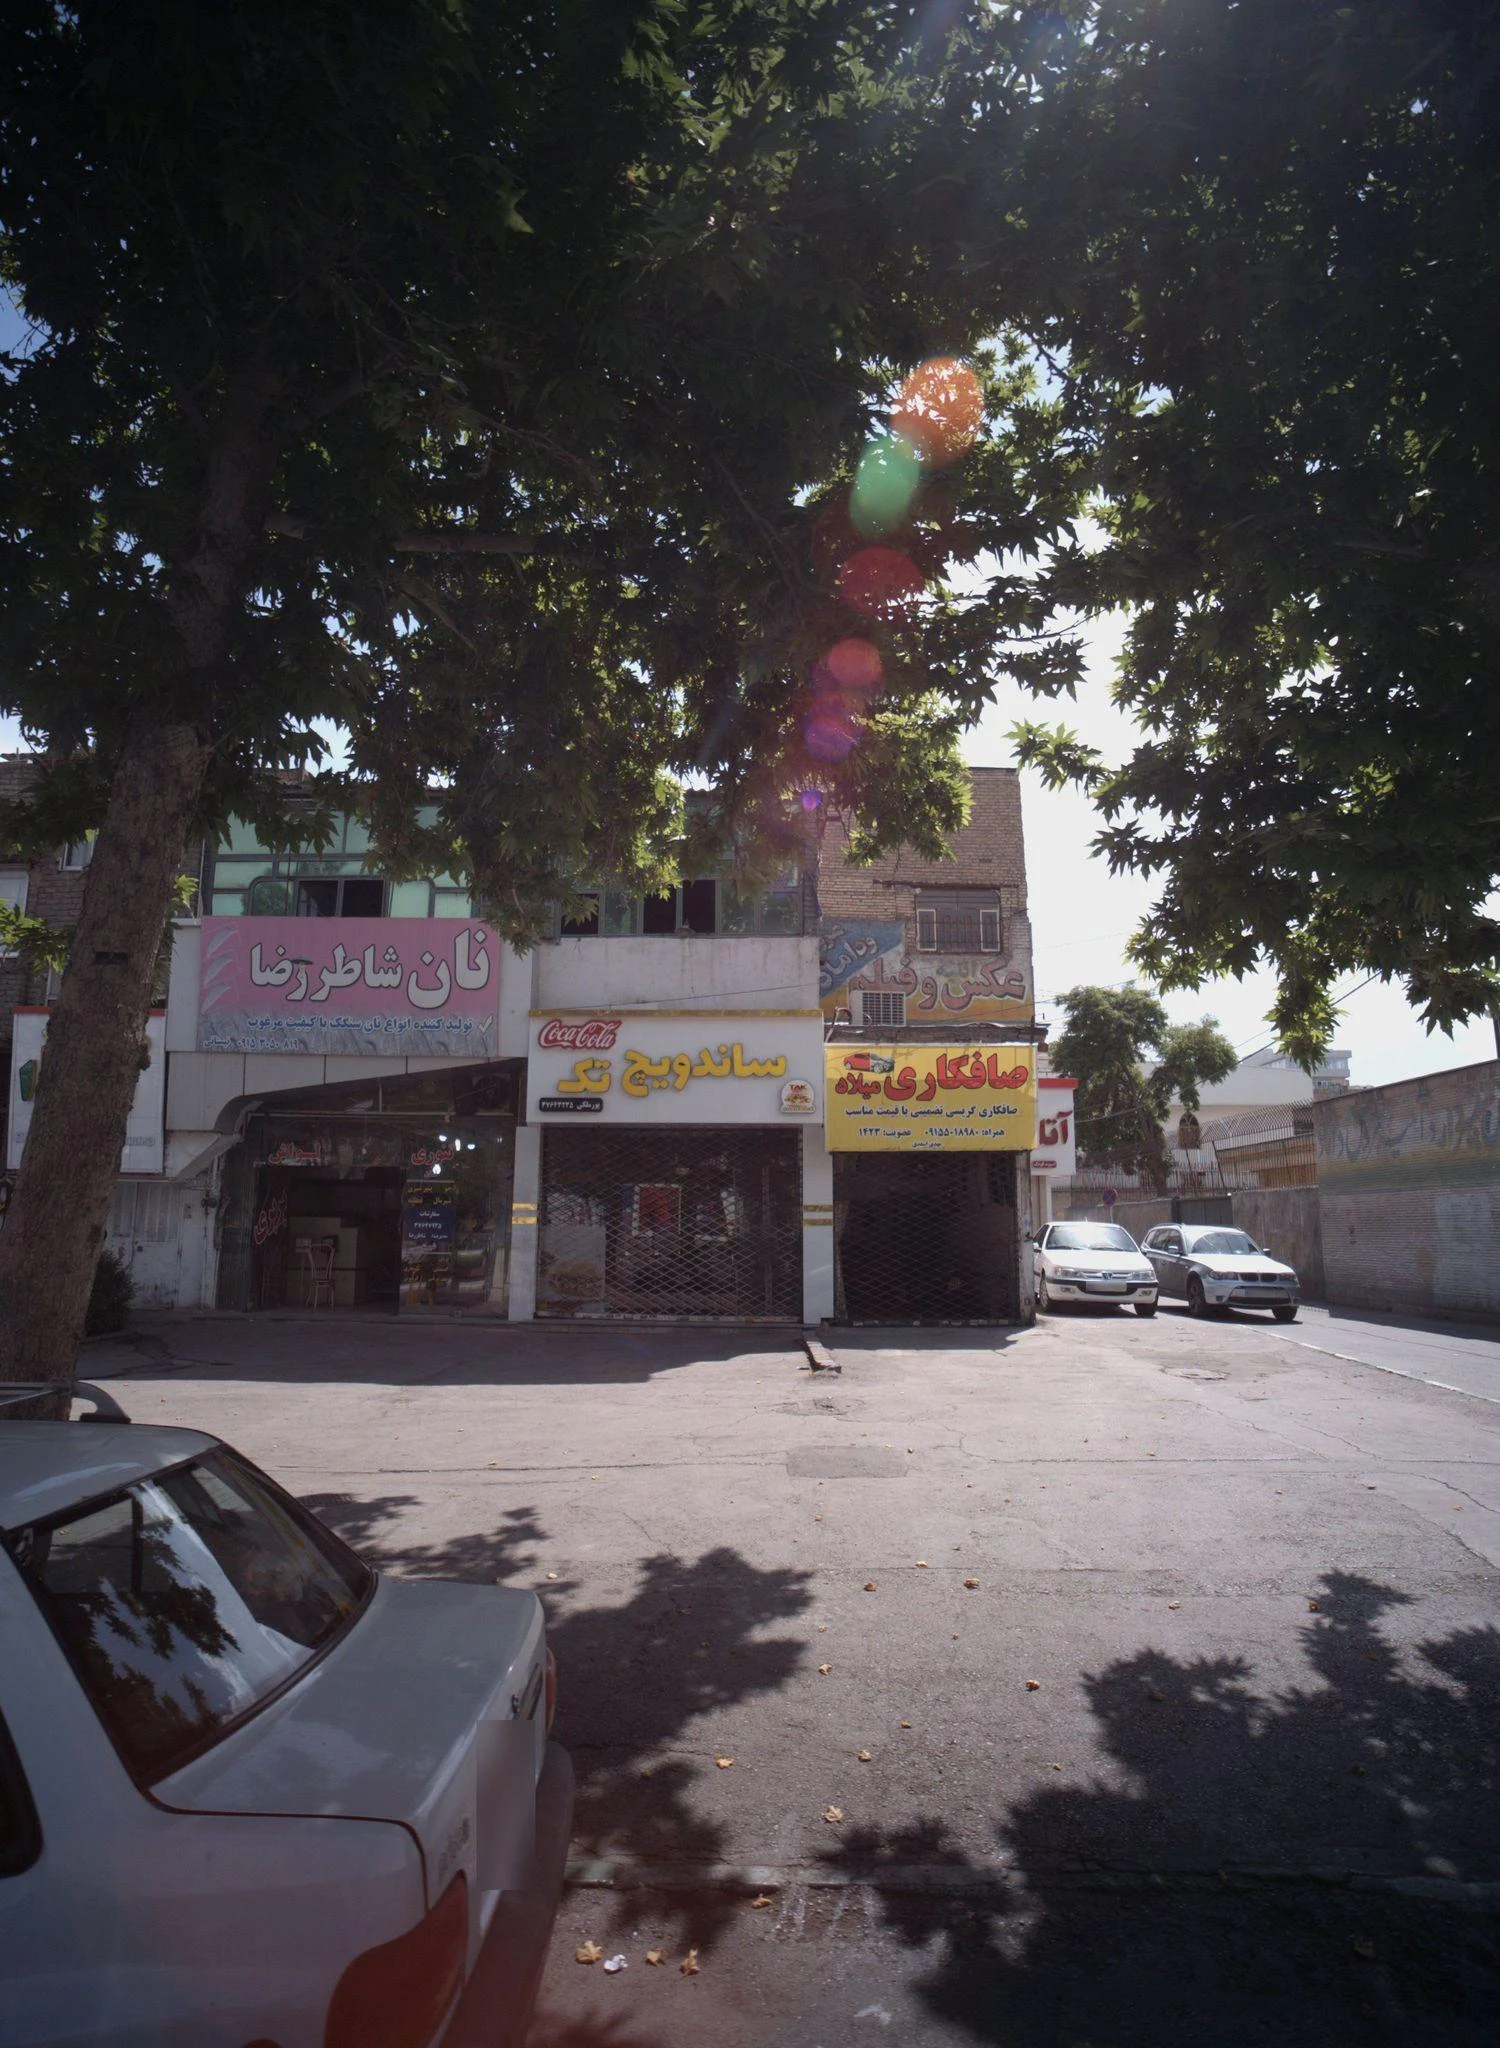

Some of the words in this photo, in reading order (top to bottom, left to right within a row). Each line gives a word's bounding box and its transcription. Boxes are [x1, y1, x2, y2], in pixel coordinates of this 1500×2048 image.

[250, 942, 309, 1002] رضا
[308, 942, 403, 1002] شاطر
[407, 927, 491, 1010] نان
[941, 957, 1027, 1012] عکس
[918, 975, 938, 1011] و
[247, 1016, 283, 1031] مرغوب
[285, 1015, 317, 1031] کیفیت
[318, 1016, 328, 1030] با
[364, 1016, 381, 1033] نان
[384, 1016, 411, 1032] انواع
[413, 1016, 443, 1031] کننده
[445, 1016, 473, 1033] تولید
[556, 1057, 612, 1094] تک
[621, 1043, 787, 1097] ساندویچ
[883, 1051, 1030, 1102] صافکاری
[845, 1105, 874, 1117] مناسب
[876, 1106, 900, 1117] قیمت
[901, 1105, 909, 1116] با
[910, 1105, 944, 1118] تضمینی
[978, 1105, 1019, 1118] صافکاری
